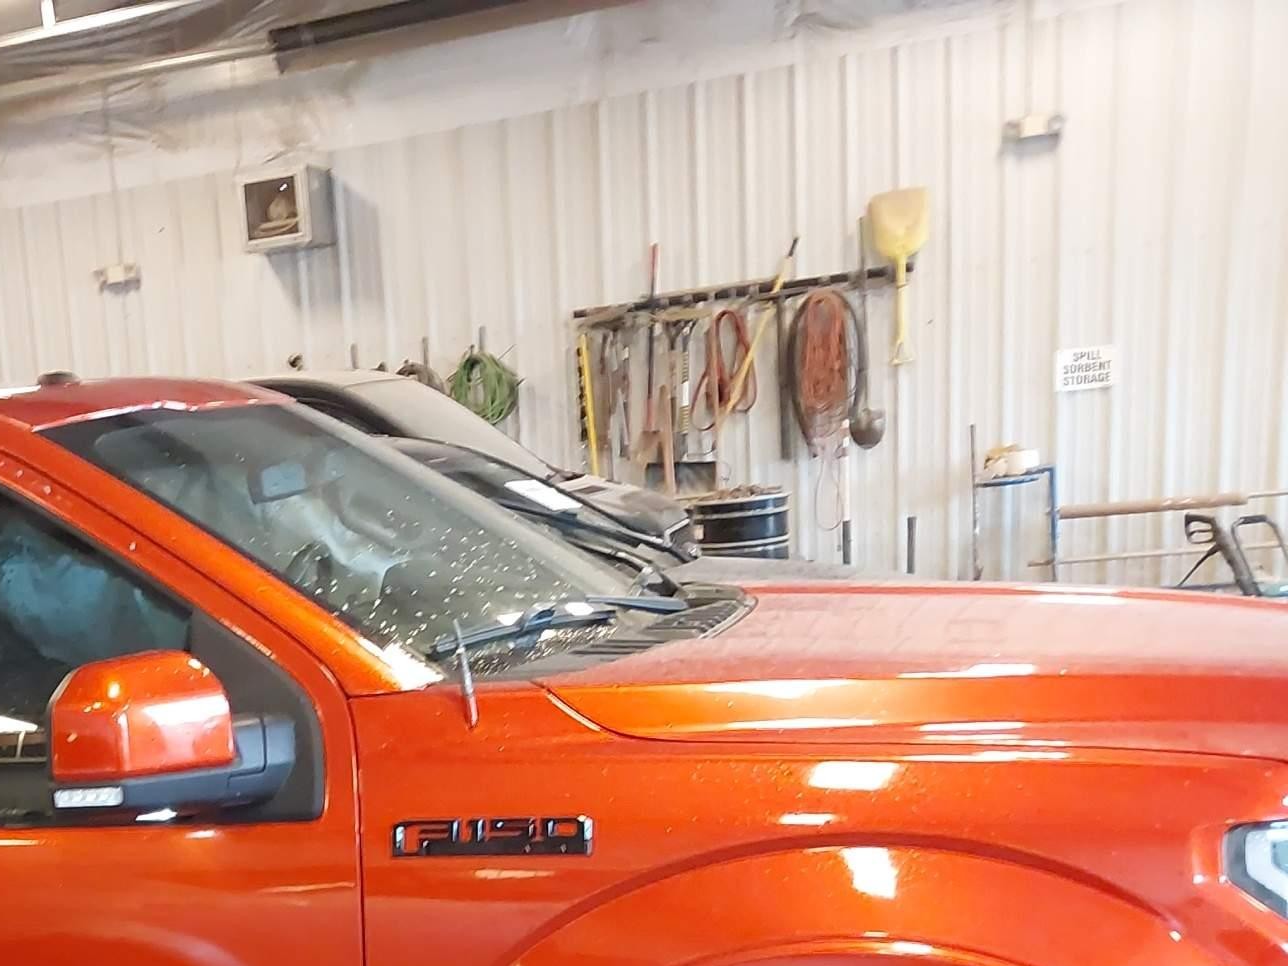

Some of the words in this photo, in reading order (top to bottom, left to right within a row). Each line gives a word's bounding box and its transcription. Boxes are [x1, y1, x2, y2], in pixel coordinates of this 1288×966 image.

[1073, 349, 1102, 362] SPILL
[1063, 360, 1113, 374] SORBENT
[1063, 372, 1112, 386] STORAGE
